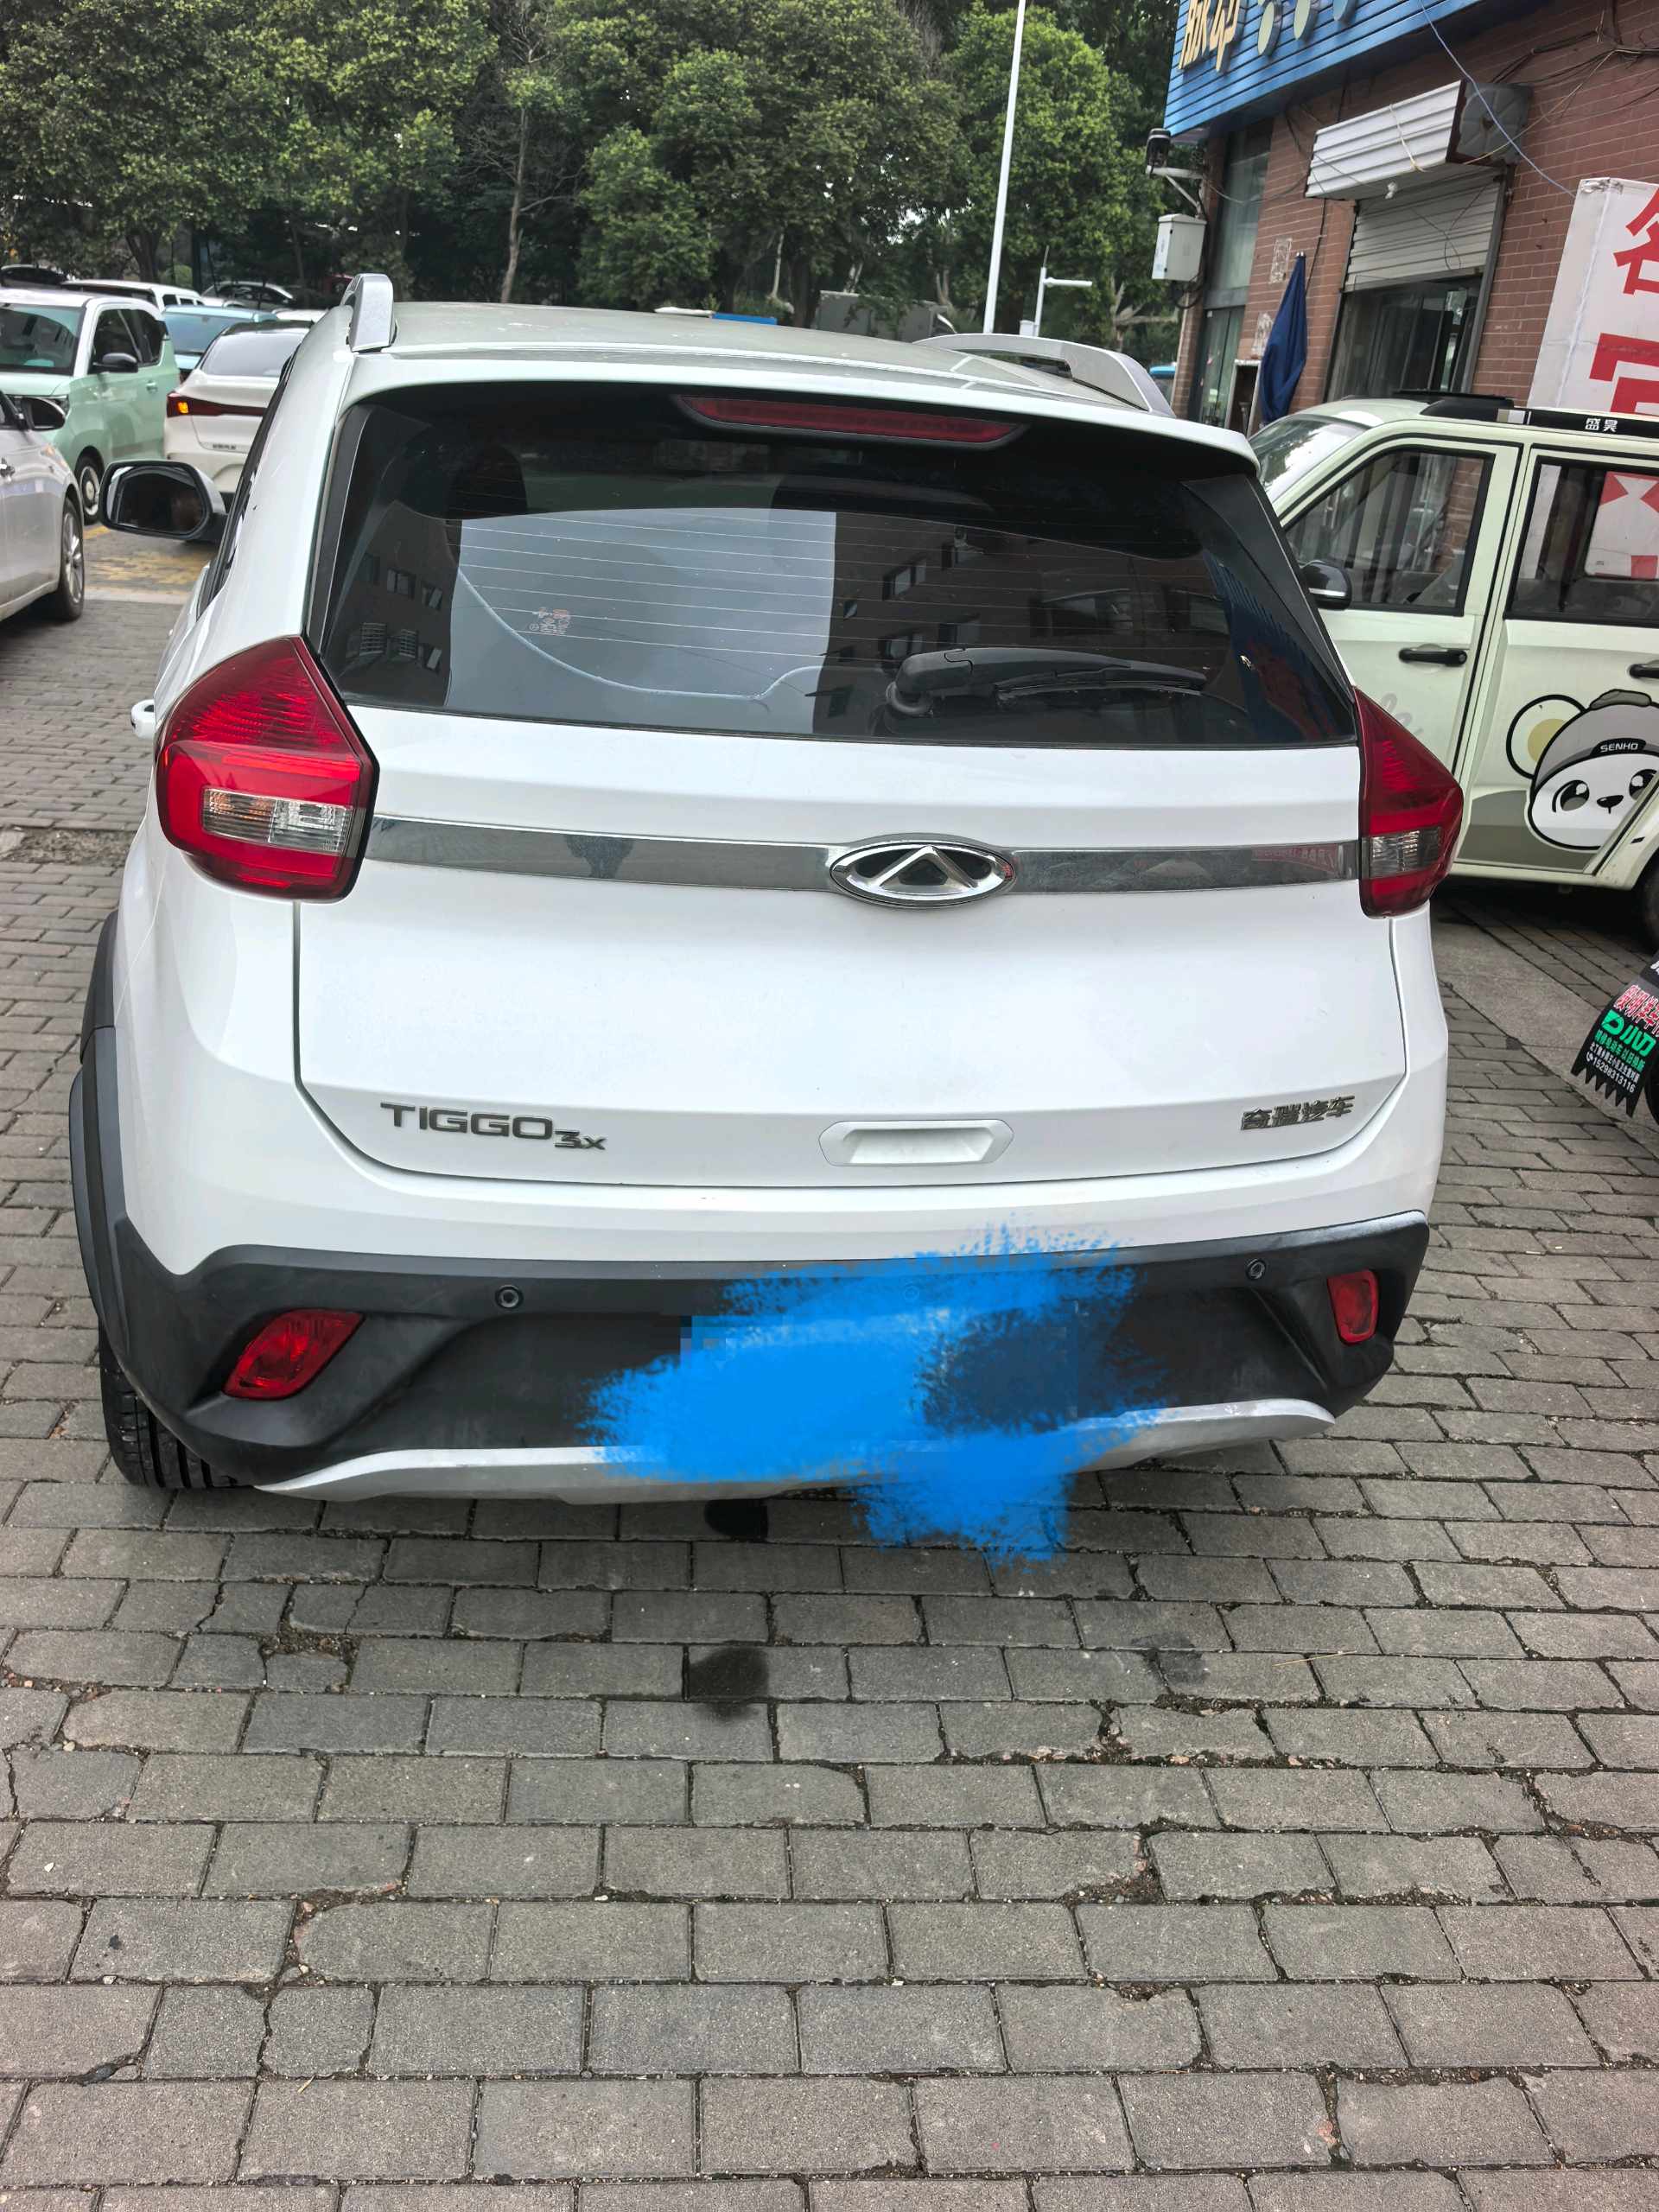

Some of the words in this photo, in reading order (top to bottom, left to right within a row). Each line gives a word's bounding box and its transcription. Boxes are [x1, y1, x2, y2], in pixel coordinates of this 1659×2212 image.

[1600, 742, 1638, 753] SENHO
[1241, 1096, 1355, 1130] 奇瑞汽车
